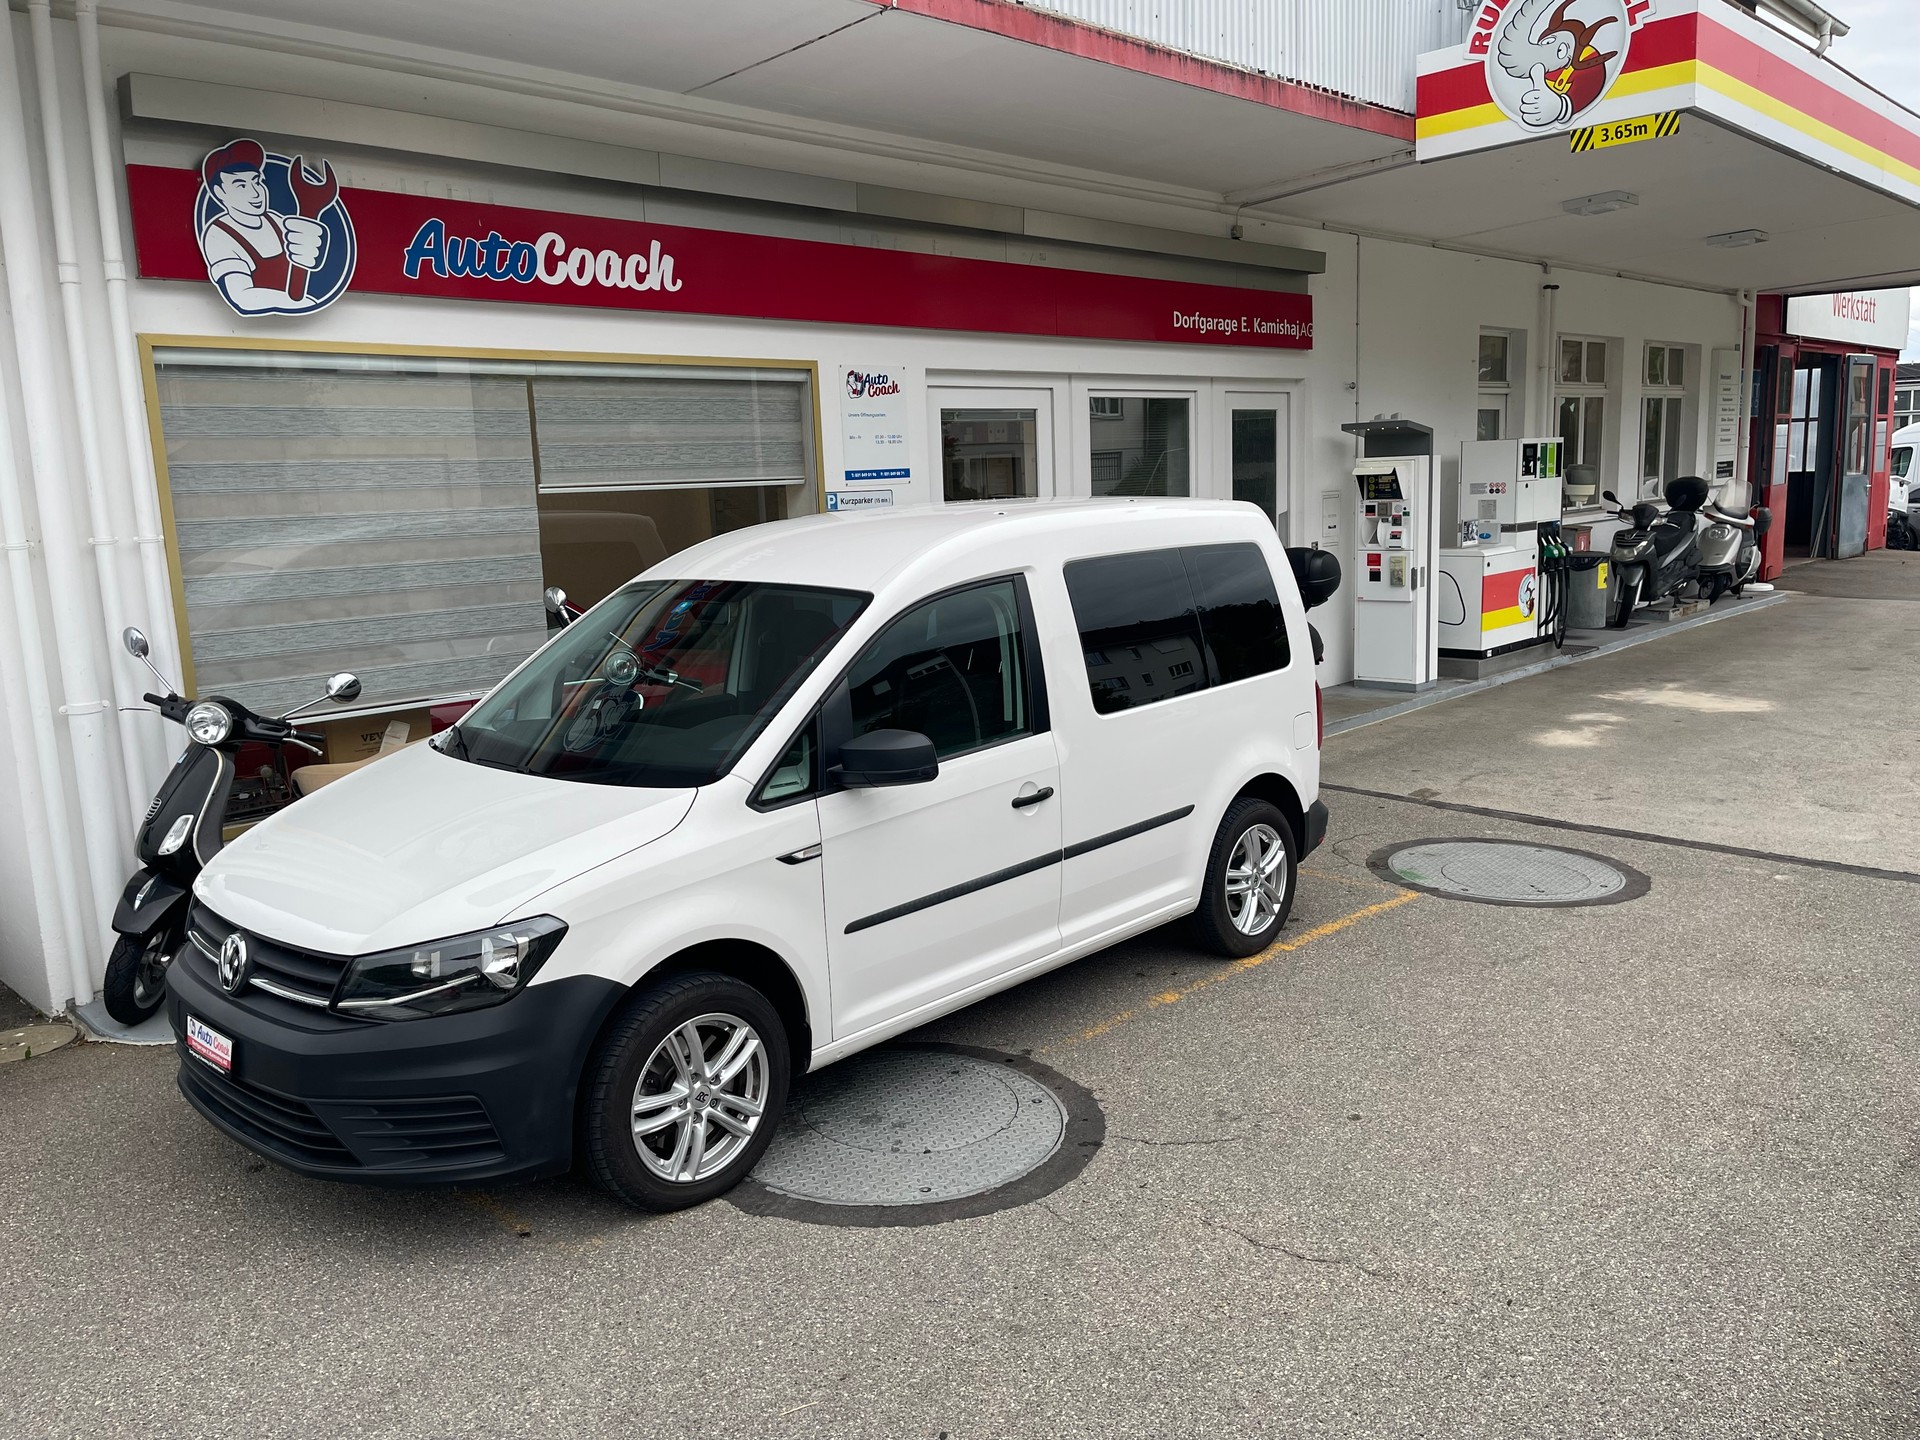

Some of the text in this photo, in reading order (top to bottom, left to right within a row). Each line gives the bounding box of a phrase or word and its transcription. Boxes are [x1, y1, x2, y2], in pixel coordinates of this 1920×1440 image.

[1601, 124, 1648, 142] 3.65m
[1832, 293, 1877, 324] Werkstatt
[1173, 311, 1238, 335] Dorfgarage
[1241, 317, 1251, 332] E.
[864, 373, 888, 388] Auto
[868, 380, 900, 398] Coach
[840, 497, 873, 505] Kurzparker
[361, 731, 385, 742] VEV
[695, 1091, 709, 1103] RC
